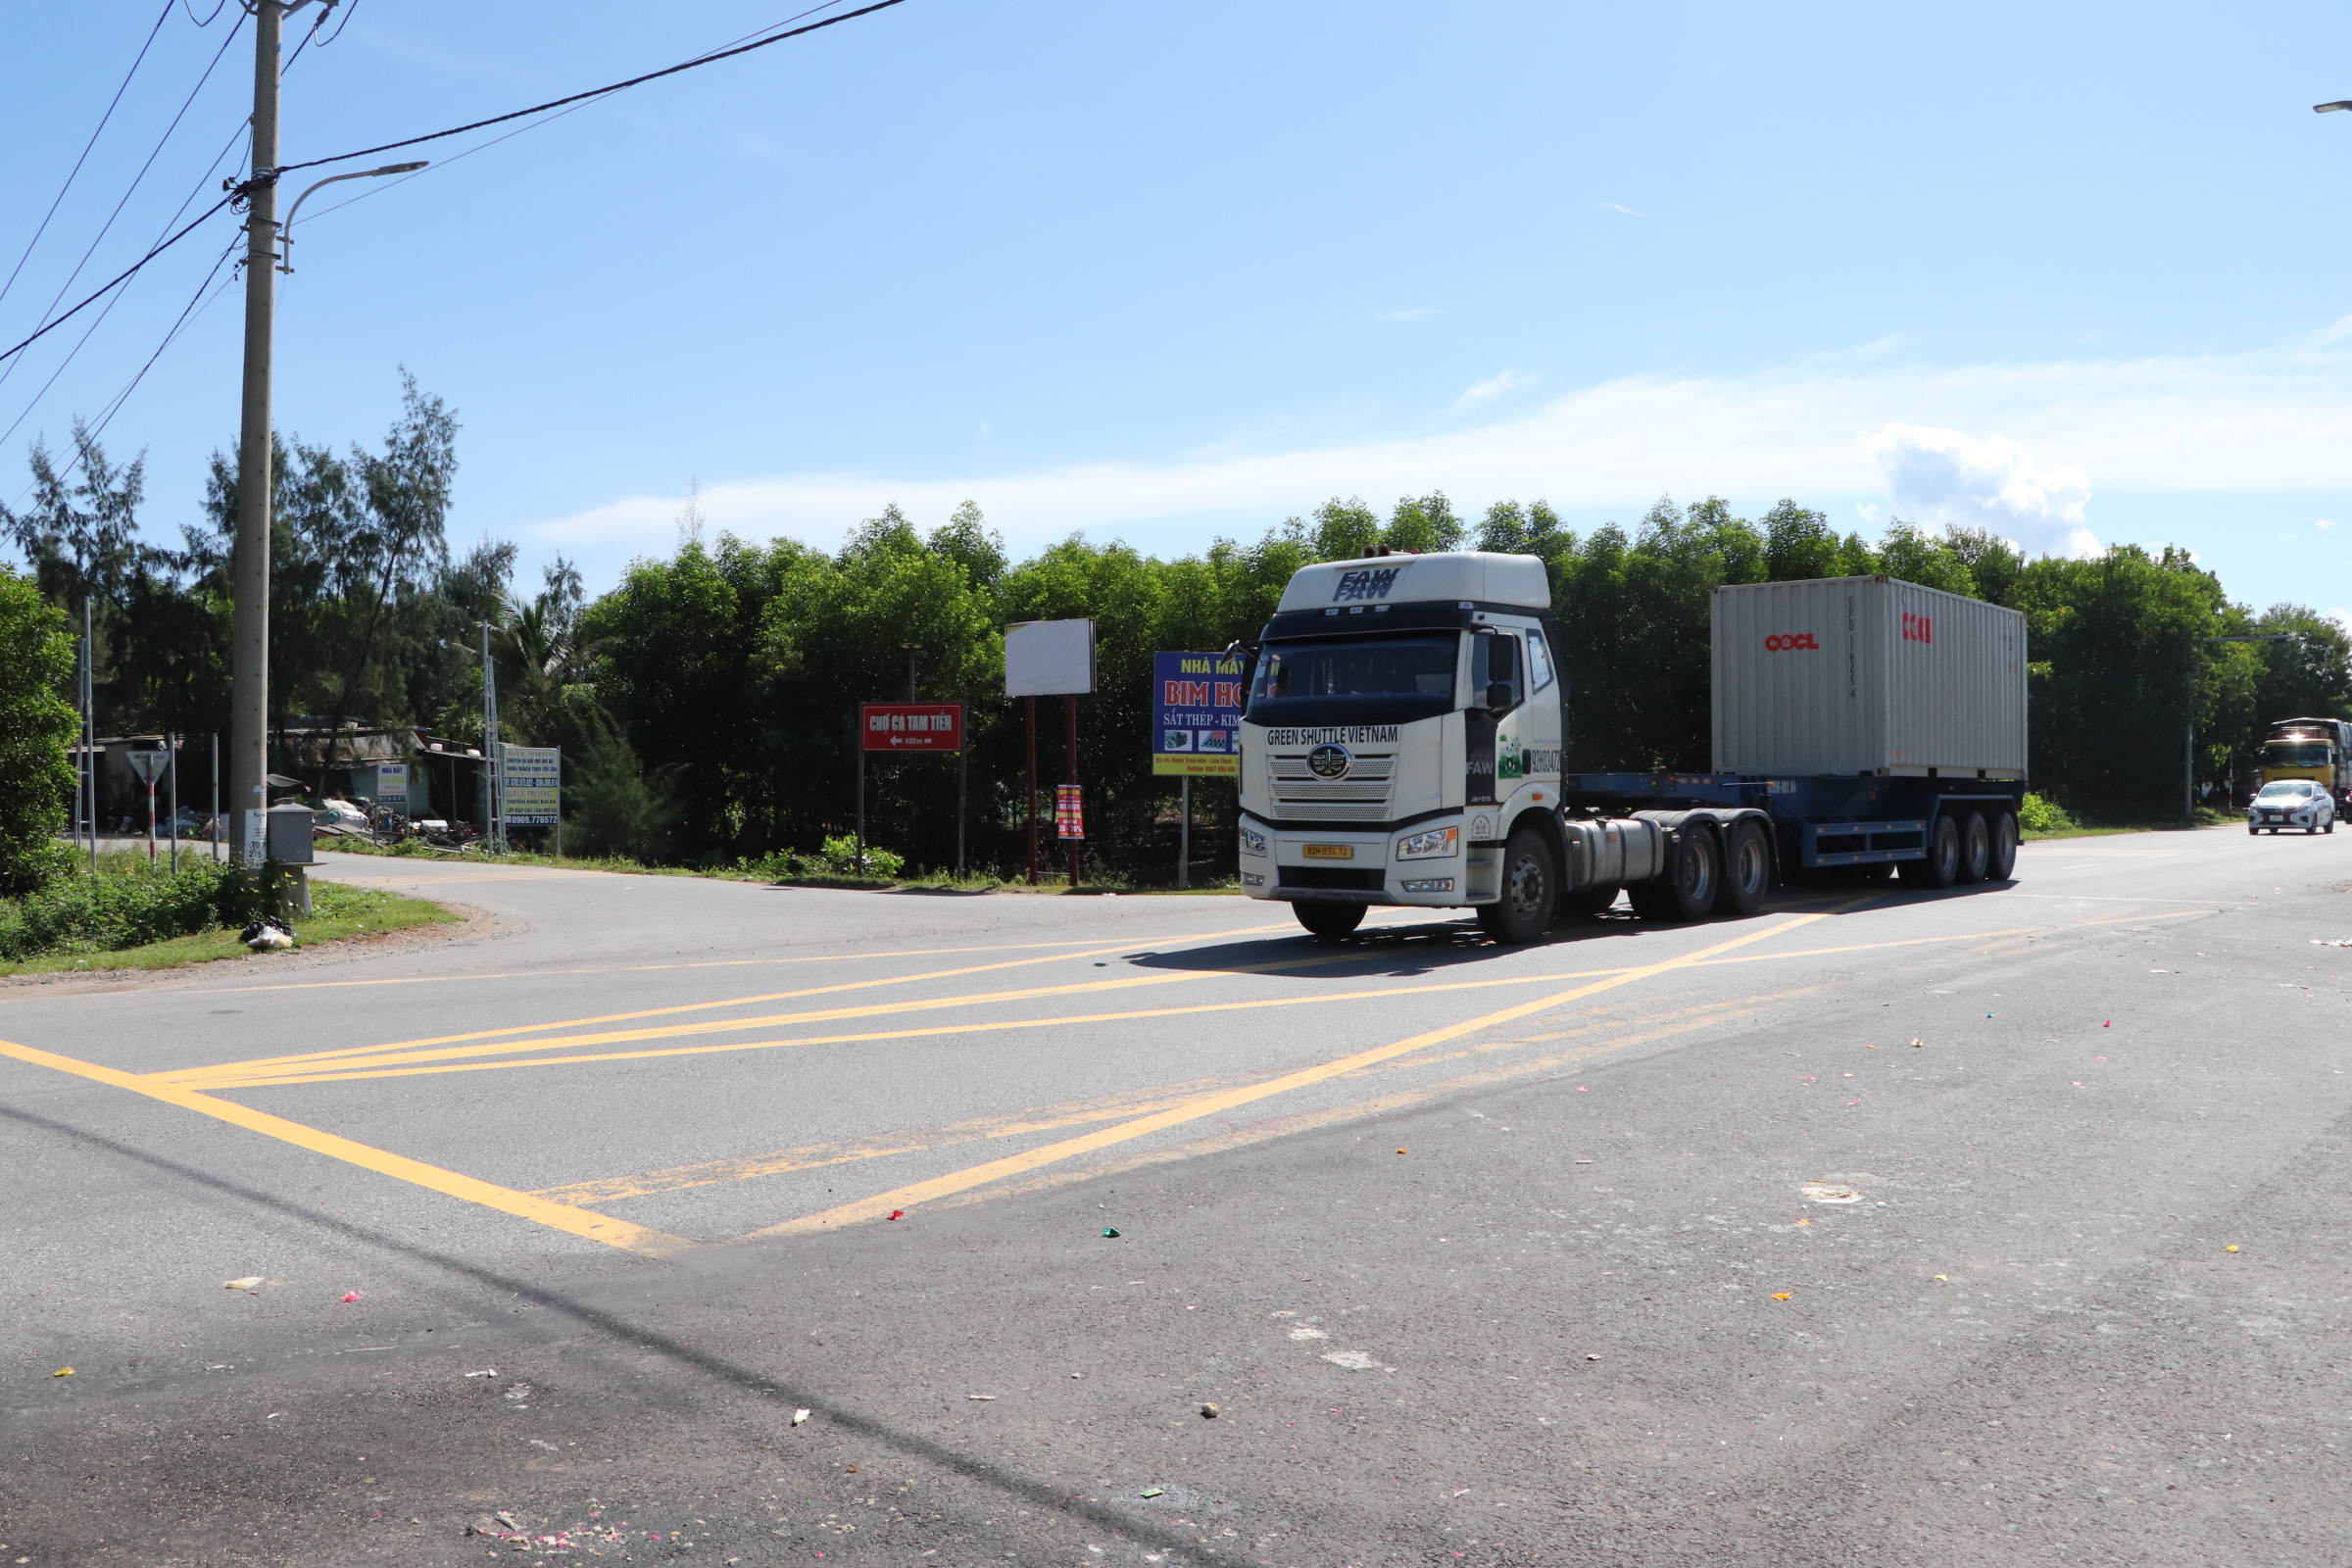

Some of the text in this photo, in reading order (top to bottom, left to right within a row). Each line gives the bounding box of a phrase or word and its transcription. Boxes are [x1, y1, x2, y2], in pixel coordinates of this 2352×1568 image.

[1765, 633, 1820, 652] OOCL
[1181, 657, 1211, 674] NHÀ
[1164, 680, 1209, 707] BIM
[1849, 688, 1856, 699] 4
[869, 710, 952, 734] CHỢ CÁ TAM TIẾN
[1163, 708, 1183, 725] SẮT
[1186, 710, 1213, 726] THÉP
[1267, 726, 1397, 745] GREEN SHUTTLE VIETNAM
[1466, 761, 1494, 774] FAW
[512, 815, 558, 824] 0969.776572
[1306, 847, 1348, 857] 92H-034.72
